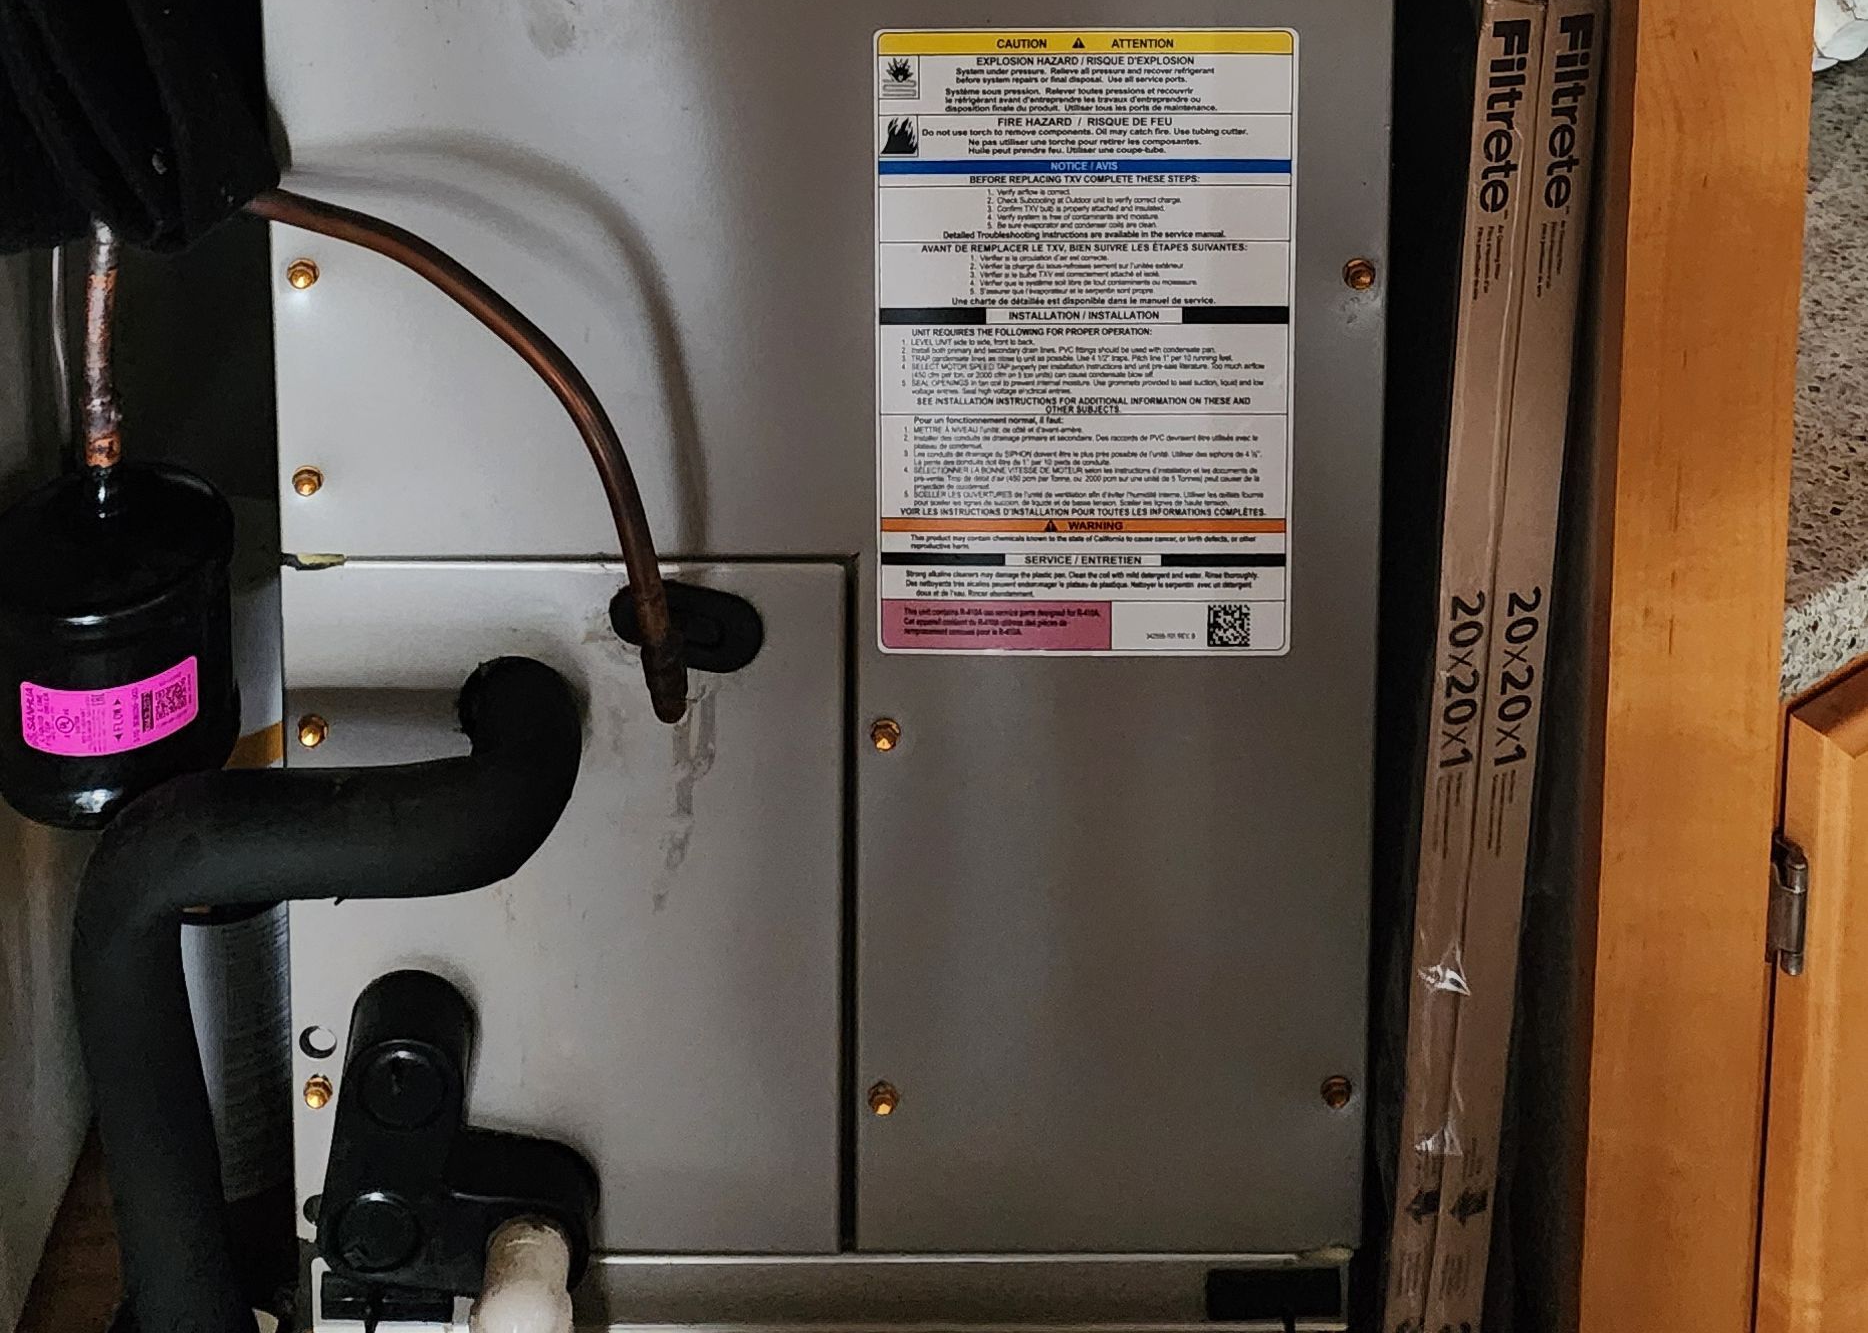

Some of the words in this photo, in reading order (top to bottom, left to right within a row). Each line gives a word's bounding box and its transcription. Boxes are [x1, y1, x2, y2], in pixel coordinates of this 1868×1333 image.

[996, 38, 1047, 49] CAUTION
[1111, 38, 1174, 49] ATTENTION
[976, 56, 1035, 66] EXPLOSION
[1036, 56, 1079, 66] HAZARD
[1086, 56, 1125, 66] RISQUE
[1127, 56, 1195, 65] D'EXPLOSION
[1479, 18, 1531, 214] Filtrete
[1544, 12, 1595, 210] Filtrete
[997, 117, 1023, 127] FIRE
[1025, 117, 1073, 127] HAZARD
[1087, 117, 1129, 127] RISQUE
[1132, 117, 1148, 127] DE
[1150, 117, 1173, 127] FEU
[1050, 161, 1088, 171] NOTICE
[1095, 161, 1118, 171] AVIS
[969, 175, 1007, 184] BEFORE
[1008, 175, 1062, 184] REPLACING
[1064, 174, 1082, 183] TXV
[1083, 174, 1134, 184] COMPLETE
[1136, 174, 1166, 183] THESE
[1167, 174, 1201, 184] STEPS:
[921, 241, 953, 253] AVANT
[954, 241, 968, 253] DE
[970, 241, 1029, 253] REMPLACER
[1031, 241, 1044, 253] LE
[1069, 241, 1092, 252] BIEN
[1093, 243, 1128, 252] SUIVRE
[1131, 243, 1150, 252] LES
[1191, 242, 1248, 252] SUIVANTES:
[1008, 311, 1081, 321] INSTALLATION
[1088, 310, 1160, 320] INSTALLATION
[1067, 521, 1124, 531] WARNING
[1024, 555, 1072, 565] SERVICE
[1081, 555, 1142, 565] ENTRETIEN
